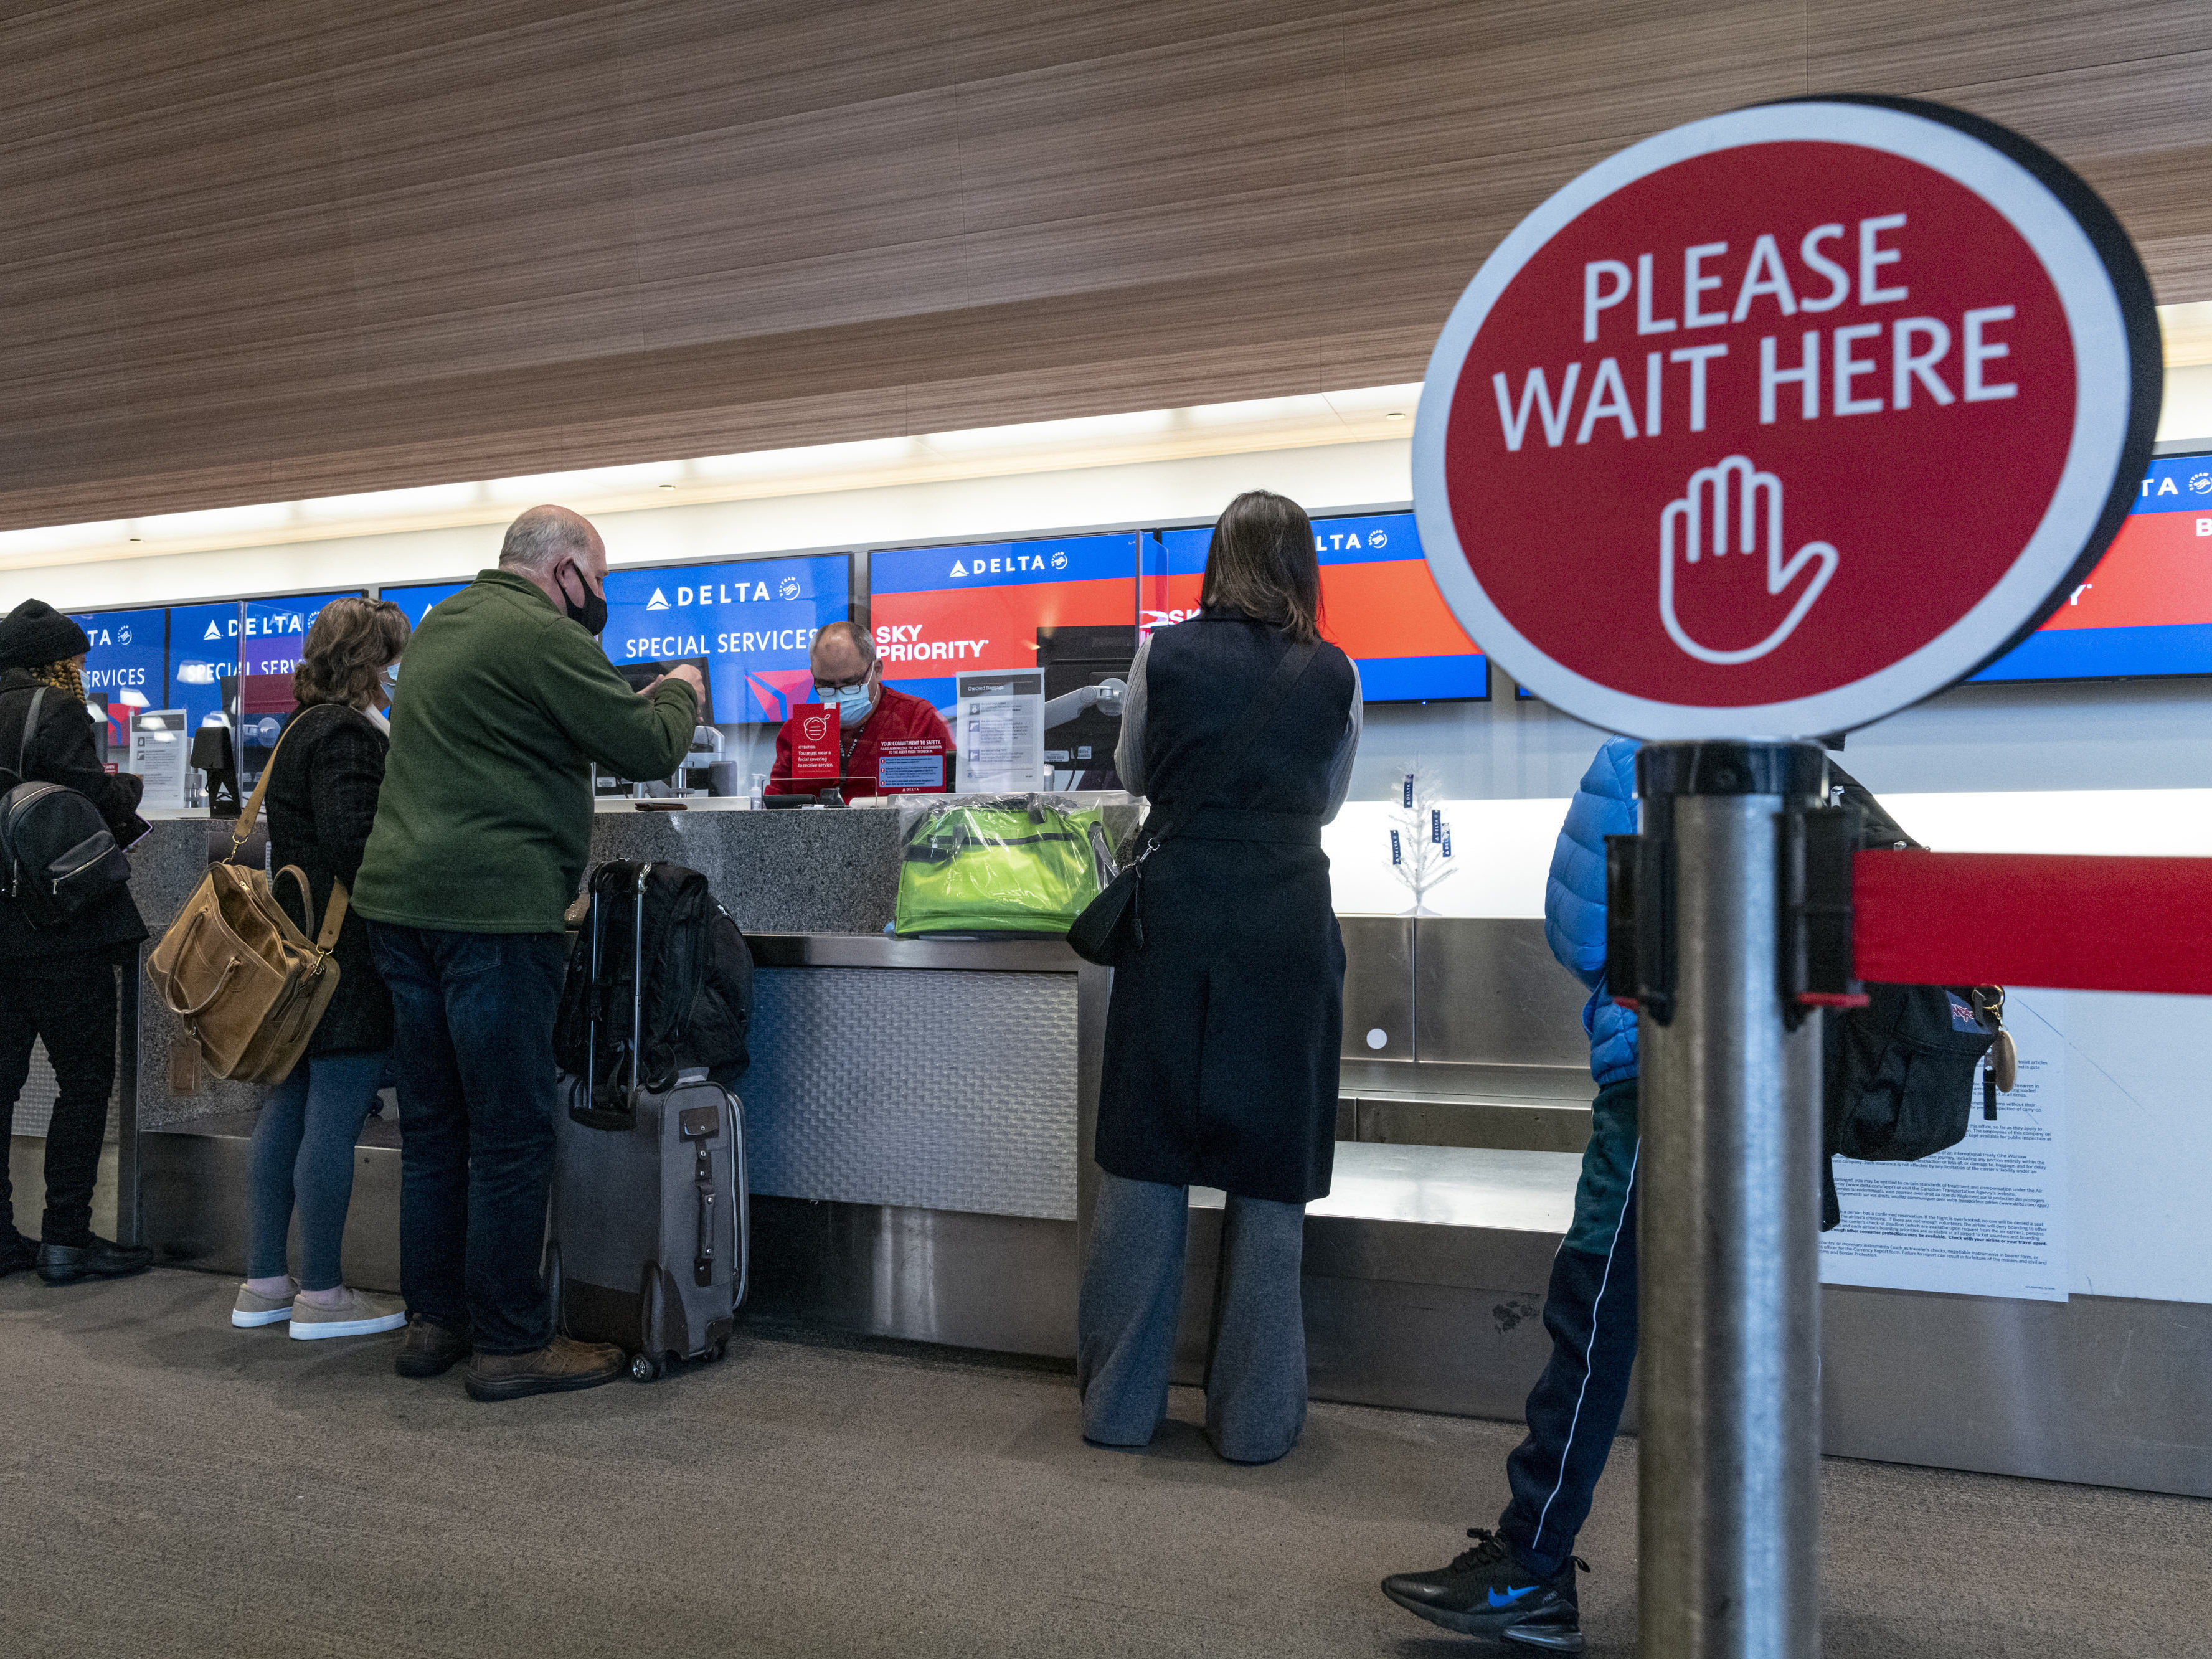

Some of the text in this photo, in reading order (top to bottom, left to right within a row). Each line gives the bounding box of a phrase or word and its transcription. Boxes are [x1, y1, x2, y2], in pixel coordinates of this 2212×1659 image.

[1583, 213, 1909, 343] PLEASE
[1492, 305, 2018, 452] WAIT HERE
[1316, 533, 1361, 551] LTA
[973, 555, 1045, 574] DELTA
[678, 581, 770, 607] DELTA
[228, 615, 302, 637] DELTA
[876, 624, 923, 643] SKY
[626, 635, 711, 658] SPECIAL
[876, 640, 986, 661] PRIORITY
[87, 668, 146, 688] RVICES
